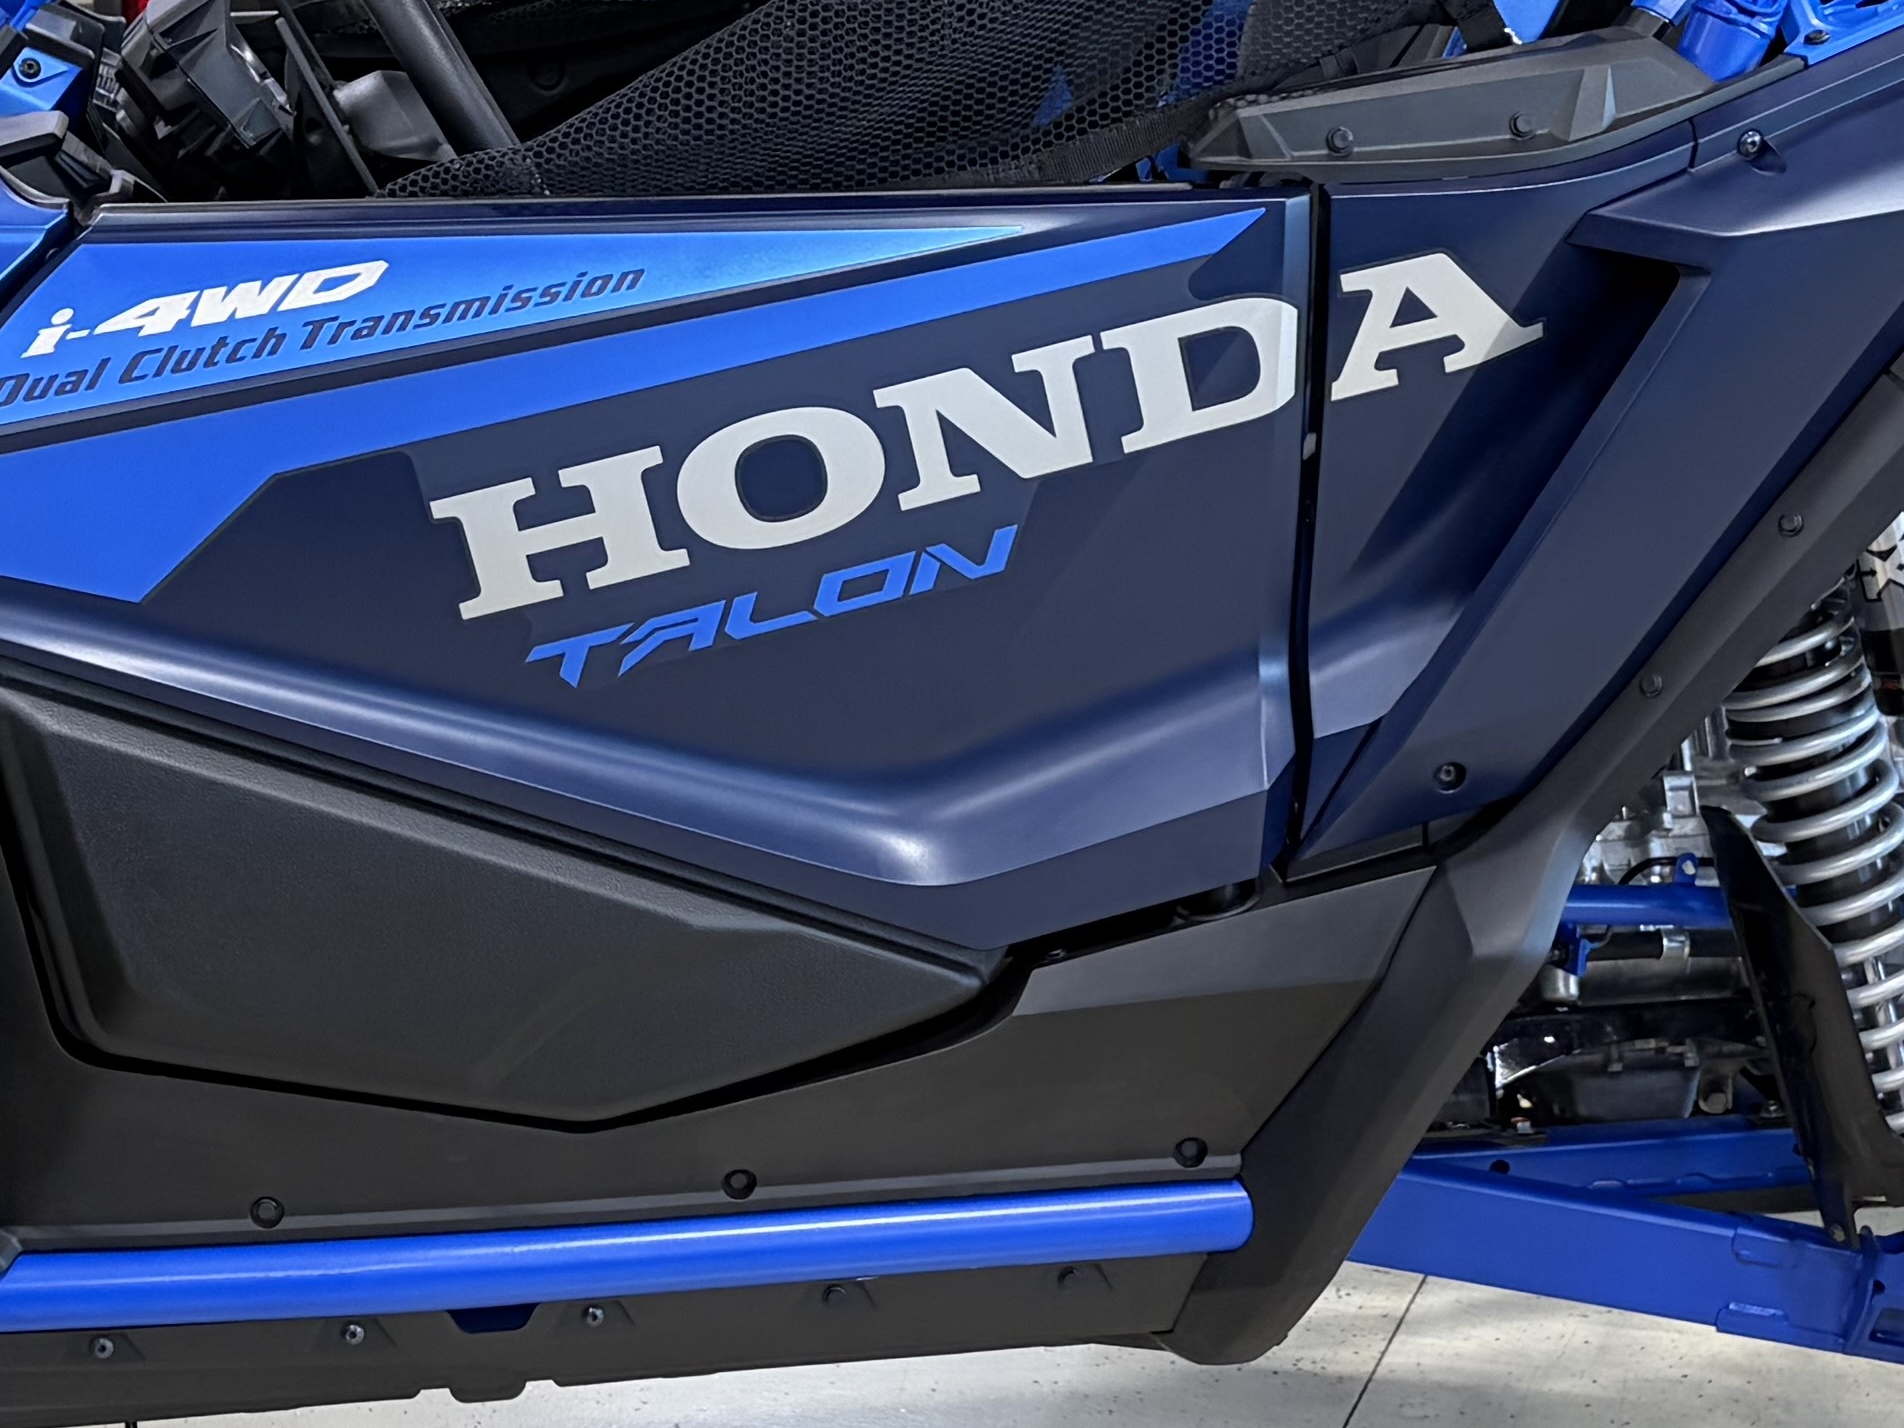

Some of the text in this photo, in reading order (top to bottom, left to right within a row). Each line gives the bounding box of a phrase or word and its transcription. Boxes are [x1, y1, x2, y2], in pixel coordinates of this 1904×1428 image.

[21, 259, 389, 359] i-4WD
[118, 325, 289, 385] Clutch
[302, 268, 646, 350] Transmission
[430, 252, 1543, 621] HONDA
[524, 523, 1018, 688] TALON
